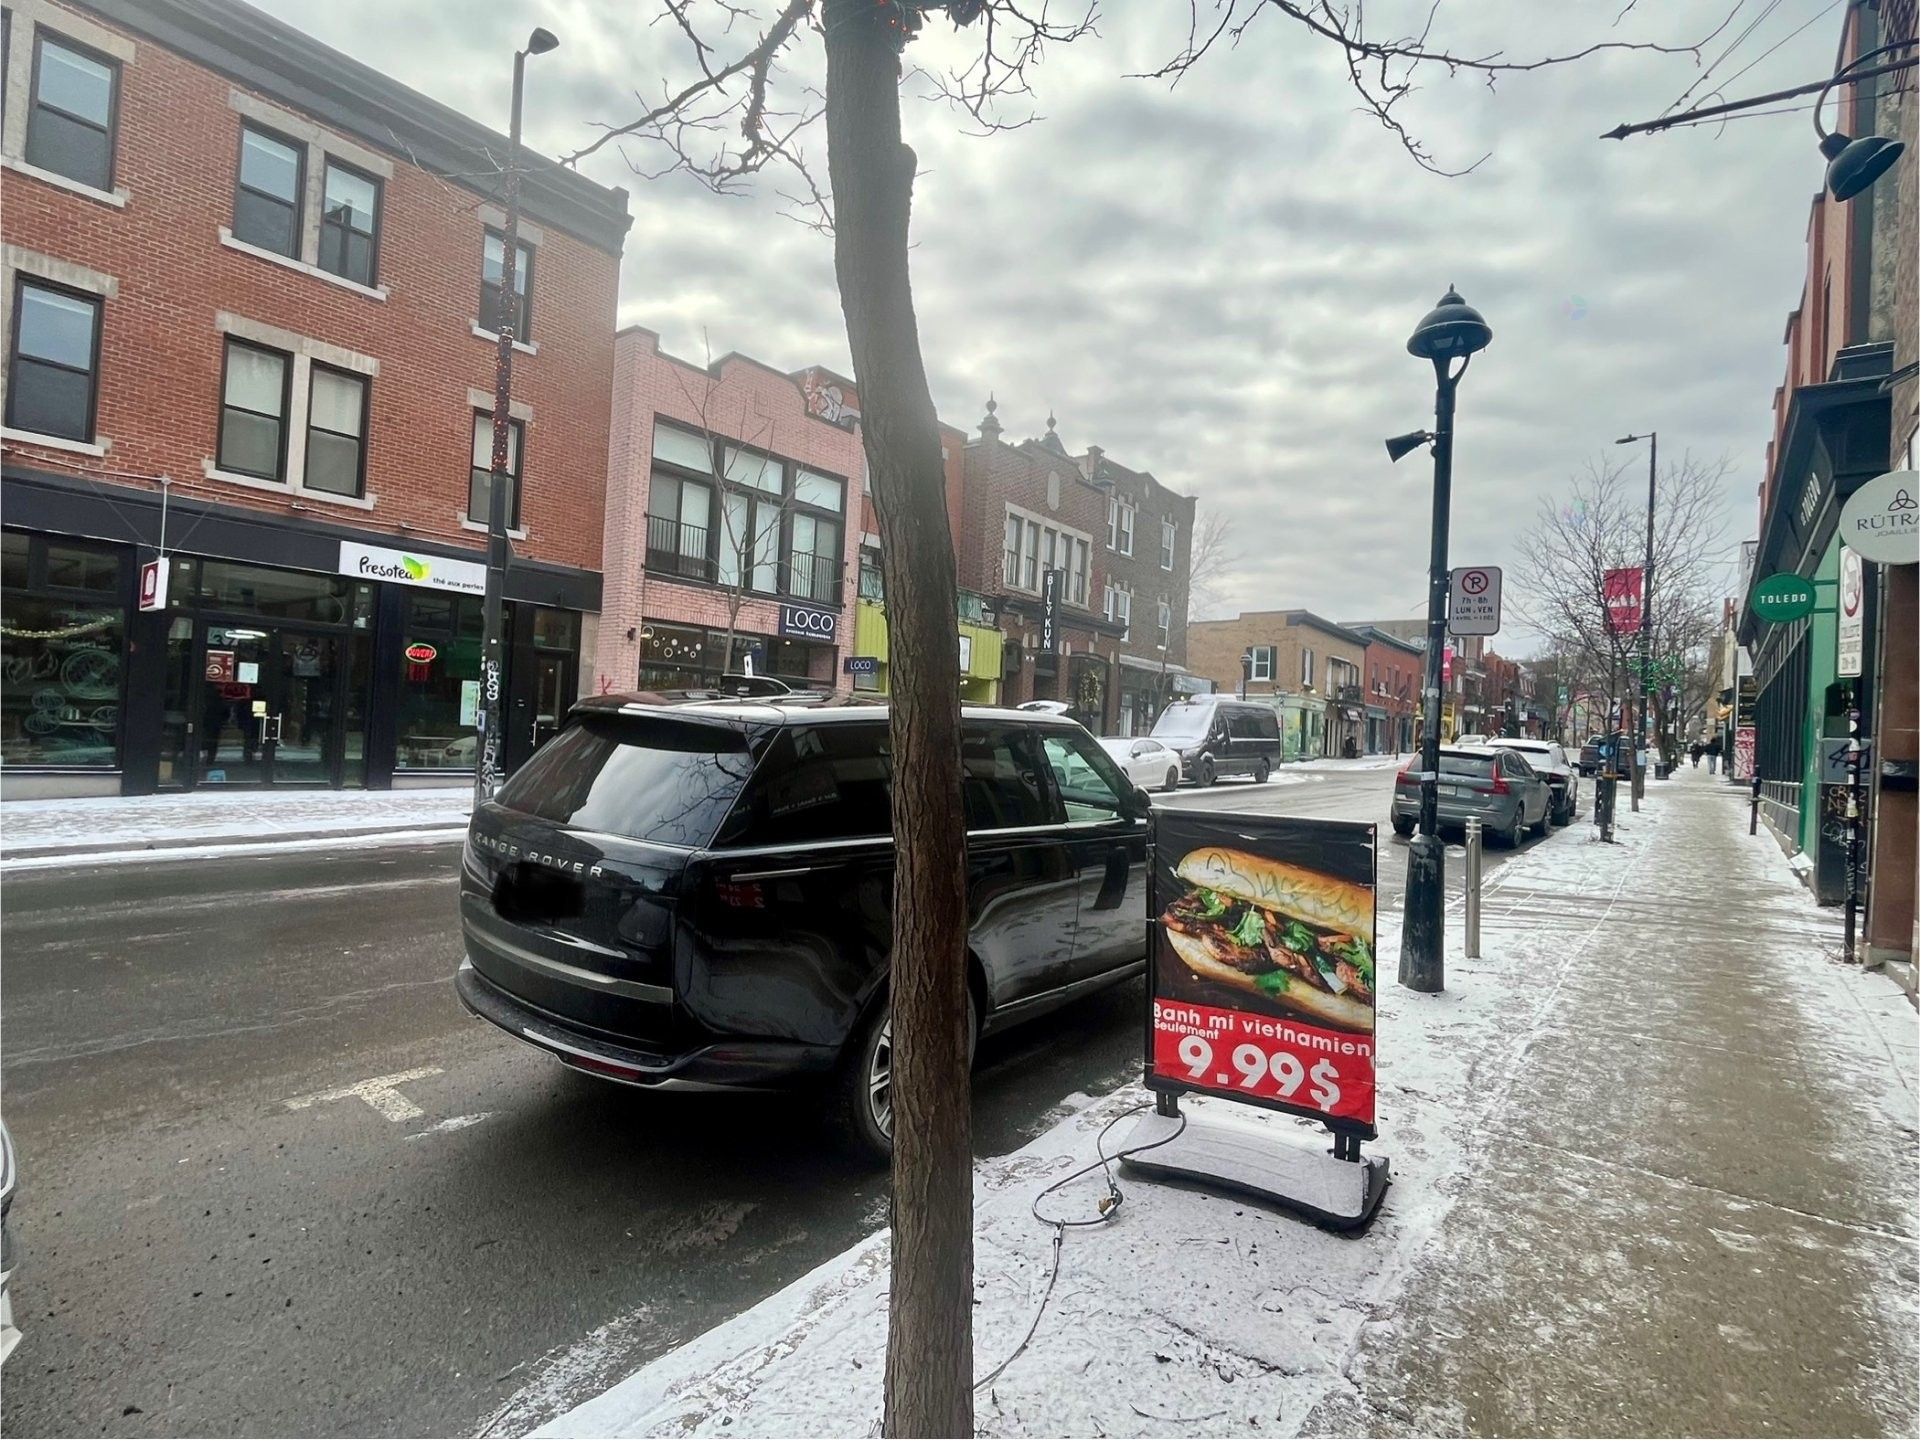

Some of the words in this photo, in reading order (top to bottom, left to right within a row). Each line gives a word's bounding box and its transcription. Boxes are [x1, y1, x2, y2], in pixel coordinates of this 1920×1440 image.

[359, 555, 415, 581] Presotea
[433, 577, 446, 586] thé
[447, 580, 461, 588] aux
[462, 581, 484, 591] perles
[1456, 606, 1471, 614] LUN
[1760, 593, 1807, 605] TOLEDO
[786, 608, 834, 632] LOCO
[1043, 618, 1052, 649] KUN
[850, 660, 871, 670] LOCO
[474, 832, 518, 857] RANGE
[529, 851, 603, 878] ROVER
[1154, 1002, 1201, 1026] Banh
[1208, 1014, 1234, 1031] mi
[1241, 1019, 1371, 1057] vietnamien
[1154, 1020, 1219, 1041] Seulement
[1178, 1034, 1341, 1113] 9.99$
